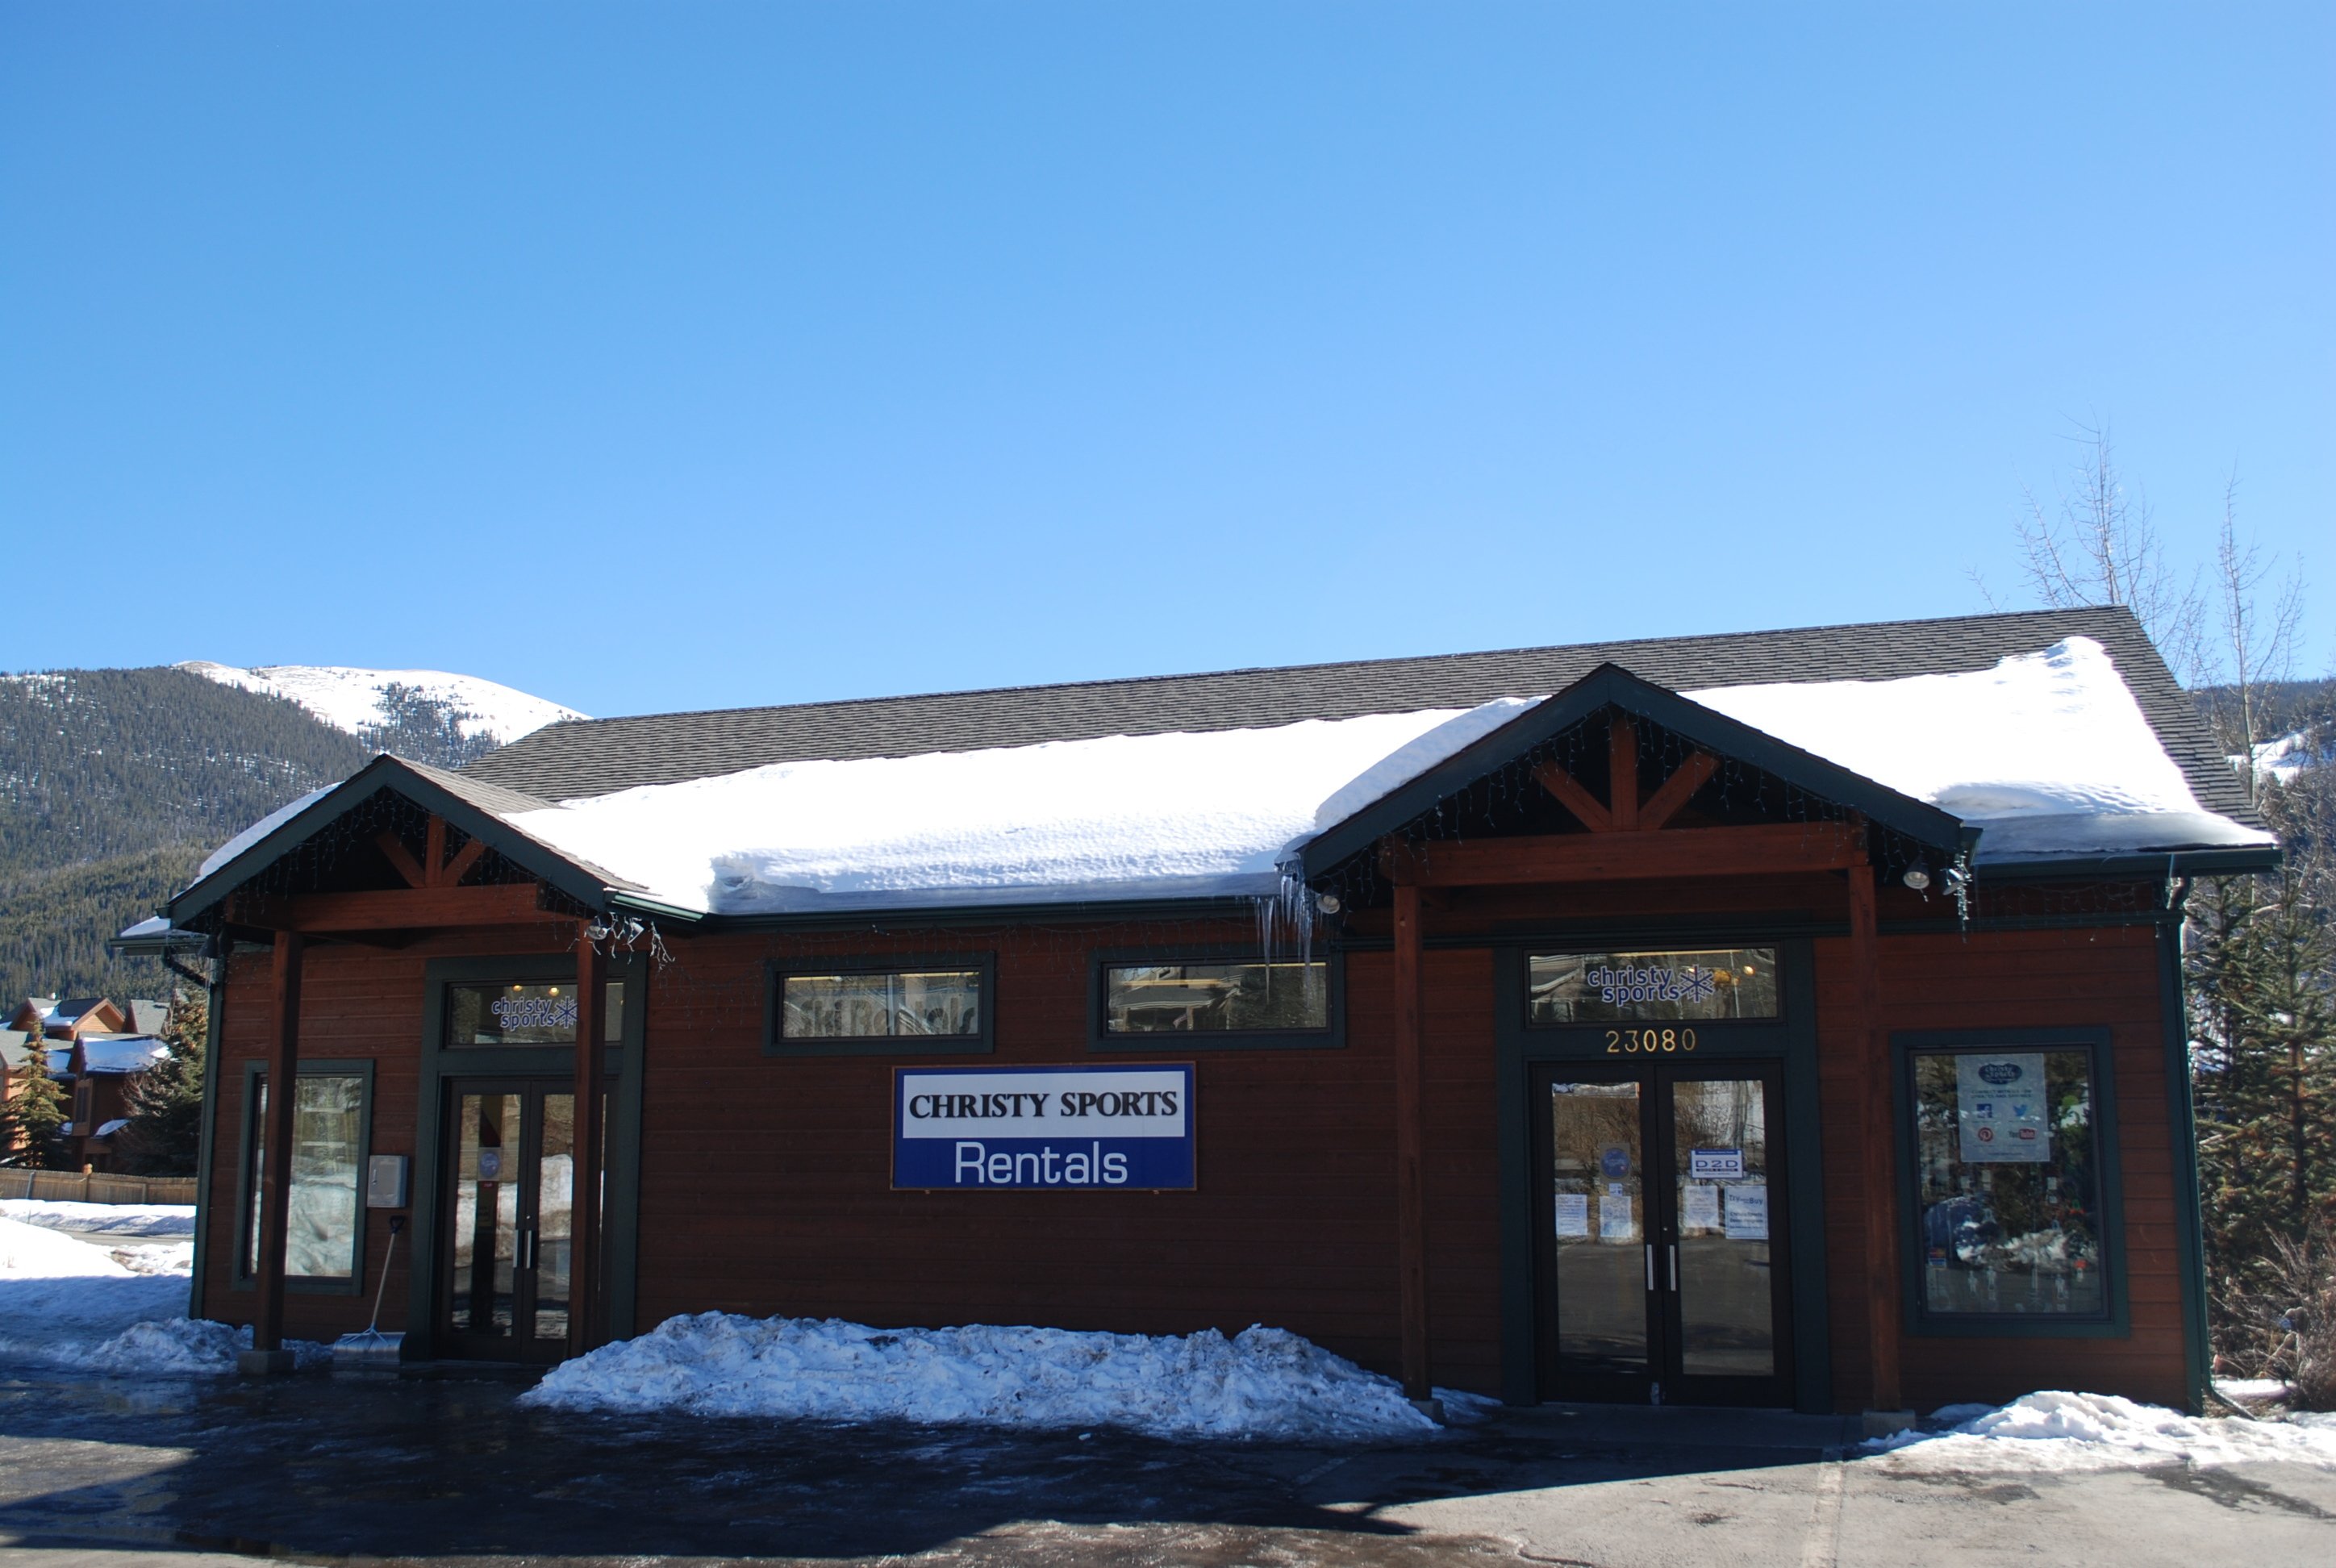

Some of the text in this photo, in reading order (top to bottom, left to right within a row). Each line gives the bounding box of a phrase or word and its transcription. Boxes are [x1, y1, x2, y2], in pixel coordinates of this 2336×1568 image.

[1587, 965, 1675, 987] christy
[491, 996, 553, 1015] christy
[1602, 983, 1681, 1007] sports
[500, 1011, 557, 1032] sports
[1605, 1028, 1696, 1053] 23080
[909, 1091, 1178, 1120] CHRISTY SPORTS
[955, 1141, 1128, 1184] Rentals
